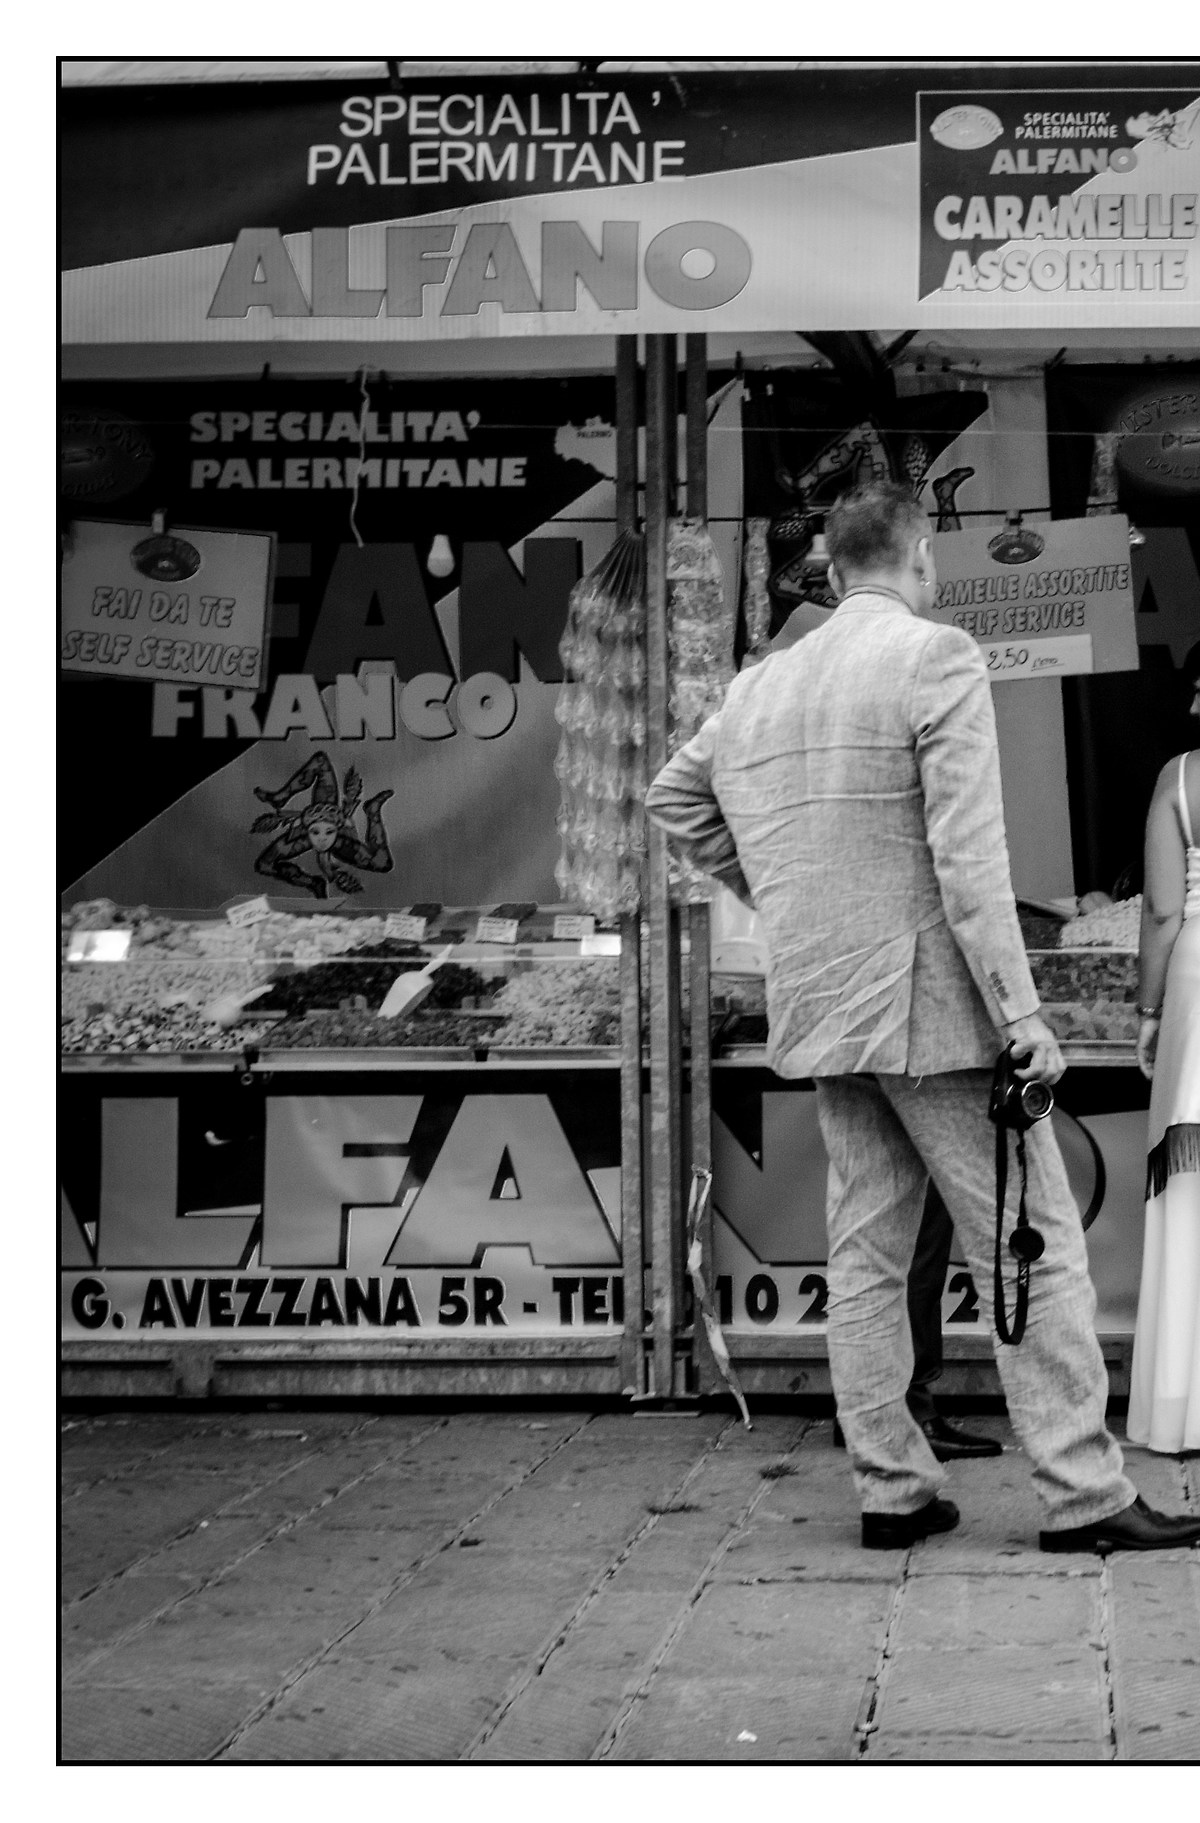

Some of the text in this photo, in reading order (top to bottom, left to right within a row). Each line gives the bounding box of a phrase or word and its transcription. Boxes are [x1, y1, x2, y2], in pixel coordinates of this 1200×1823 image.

[338, 90, 663, 138] SPECIALITA'
[1014, 125, 1119, 140] PALERMITANE
[1023, 111, 1110, 126] SPECIALITA'
[306, 140, 687, 186] PALERMITANE
[989, 147, 1139, 175] ALFANO
[932, 193, 1200, 241] CARAMELLE
[205, 219, 753, 320] ALFANO
[942, 248, 1189, 293] ASSORTITE
[189, 411, 481, 443] SPECIALITA'
[189, 456, 528, 489] PALERMITANE
[91, 586, 237, 630] FAI DA TE
[931, 563, 1129, 609] RAMELLE ASSORTITE
[1002, 601, 1086, 634] SERVICE
[61, 630, 260, 679] SELF SERVICE
[151, 670, 518, 741] FRANCO
[71, 1277, 126, 1329] G.
[138, 1277, 422, 1329] AVEZZANA
[438, 1276, 508, 1327] 5R
